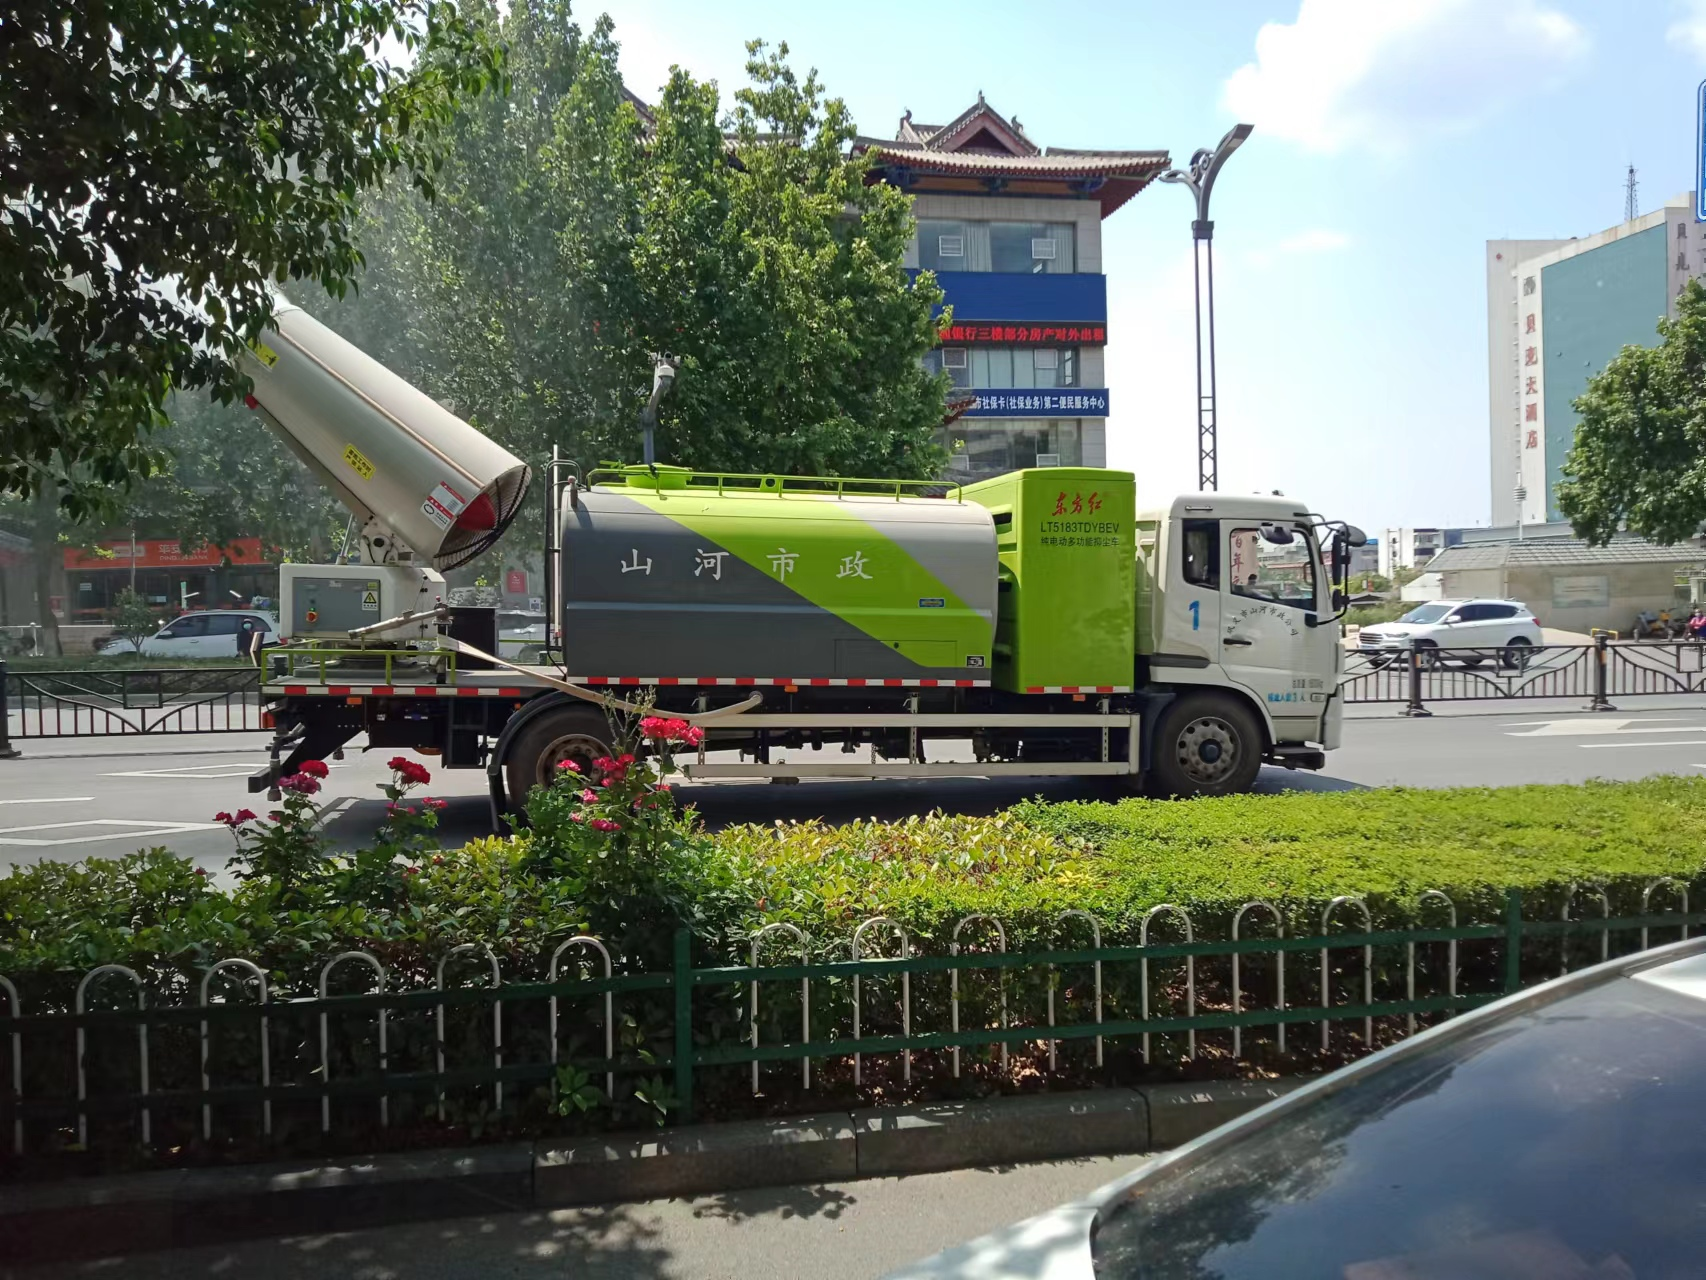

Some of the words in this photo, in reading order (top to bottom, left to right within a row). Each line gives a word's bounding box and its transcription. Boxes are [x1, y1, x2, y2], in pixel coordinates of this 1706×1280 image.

[1052, 492, 1103, 516] 东方红
[1040, 521, 1120, 533] LT5183TDYBEV
[159, 544, 209, 554] 平安
[620, 547, 874, 582] 山河市政
[1189, 600, 1200, 631] 1
